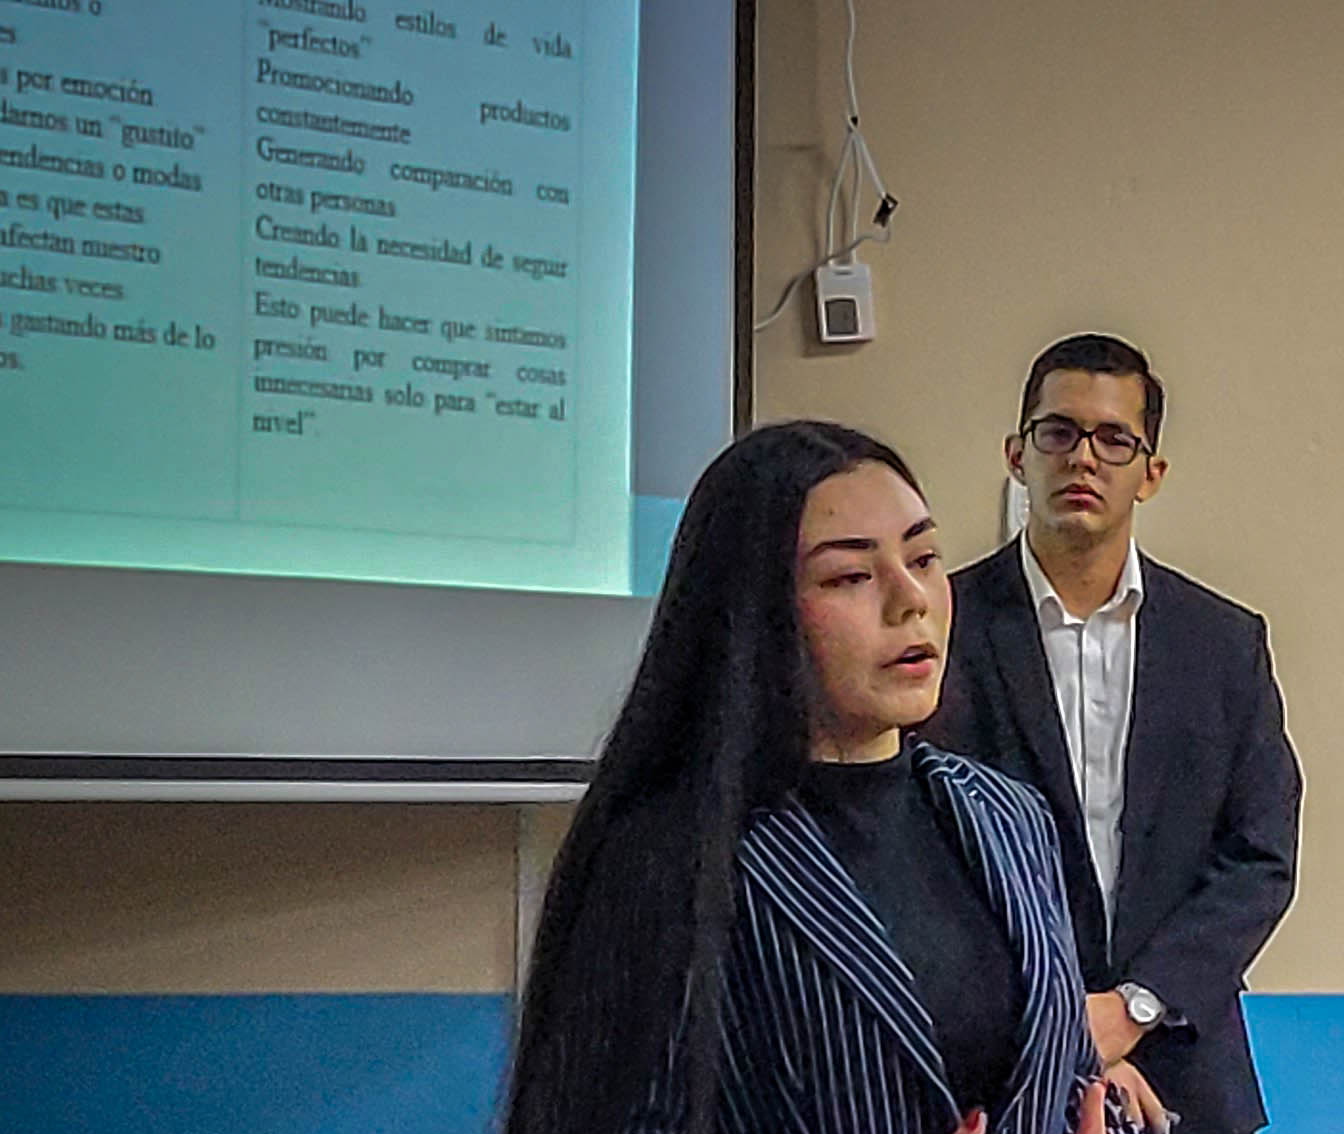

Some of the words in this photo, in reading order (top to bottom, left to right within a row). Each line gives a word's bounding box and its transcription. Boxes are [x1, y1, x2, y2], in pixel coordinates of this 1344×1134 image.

[395, 11, 457, 39] estilos
[483, 21, 507, 47] de
[532, 32, 572, 58] vida
[17, 69, 53, 93] por
[61, 76, 153, 106] emoción
[256, 57, 414, 105] Promocionando
[480, 99, 571, 131] productos
[76, 115, 103, 138] un
[256, 106, 412, 144] constantemente
[113, 163, 126, 181] o
[133, 162, 202, 191] modas
[257, 136, 365, 175] Generando
[390, 163, 513, 196] comparación
[536, 184, 569, 205] con
[47, 196, 86, 221] que
[92, 201, 145, 224] estas
[256, 181, 304, 206] otras
[310, 191, 396, 217] personas
[82, 238, 161, 265] nuestro
[256, 214, 339, 248] Creando
[351, 224, 368, 253] la
[376, 239, 472, 265] necesidad
[480, 244, 504, 269] de
[512, 255, 568, 280] seguir
[64, 276, 124, 300] veces
[255, 256, 360, 288] tendencias
[10, 313, 107, 338] gastando
[114, 317, 157, 344] más
[163, 321, 190, 348] de
[195, 324, 216, 350] lo
[255, 291, 299, 319] Esto
[311, 302, 370, 328] puede
[379, 304, 432, 333] hacer
[441, 319, 476, 343] que
[485, 324, 567, 350] sintamos
[255, 335, 328, 362] presión
[354, 349, 387, 372] por
[412, 356, 491, 381] comprar
[516, 366, 567, 386] cosas
[254, 375, 374, 403] innecesarias
[384, 381, 425, 408] solo
[434, 393, 476, 415] para
[550, 397, 566, 421] al
